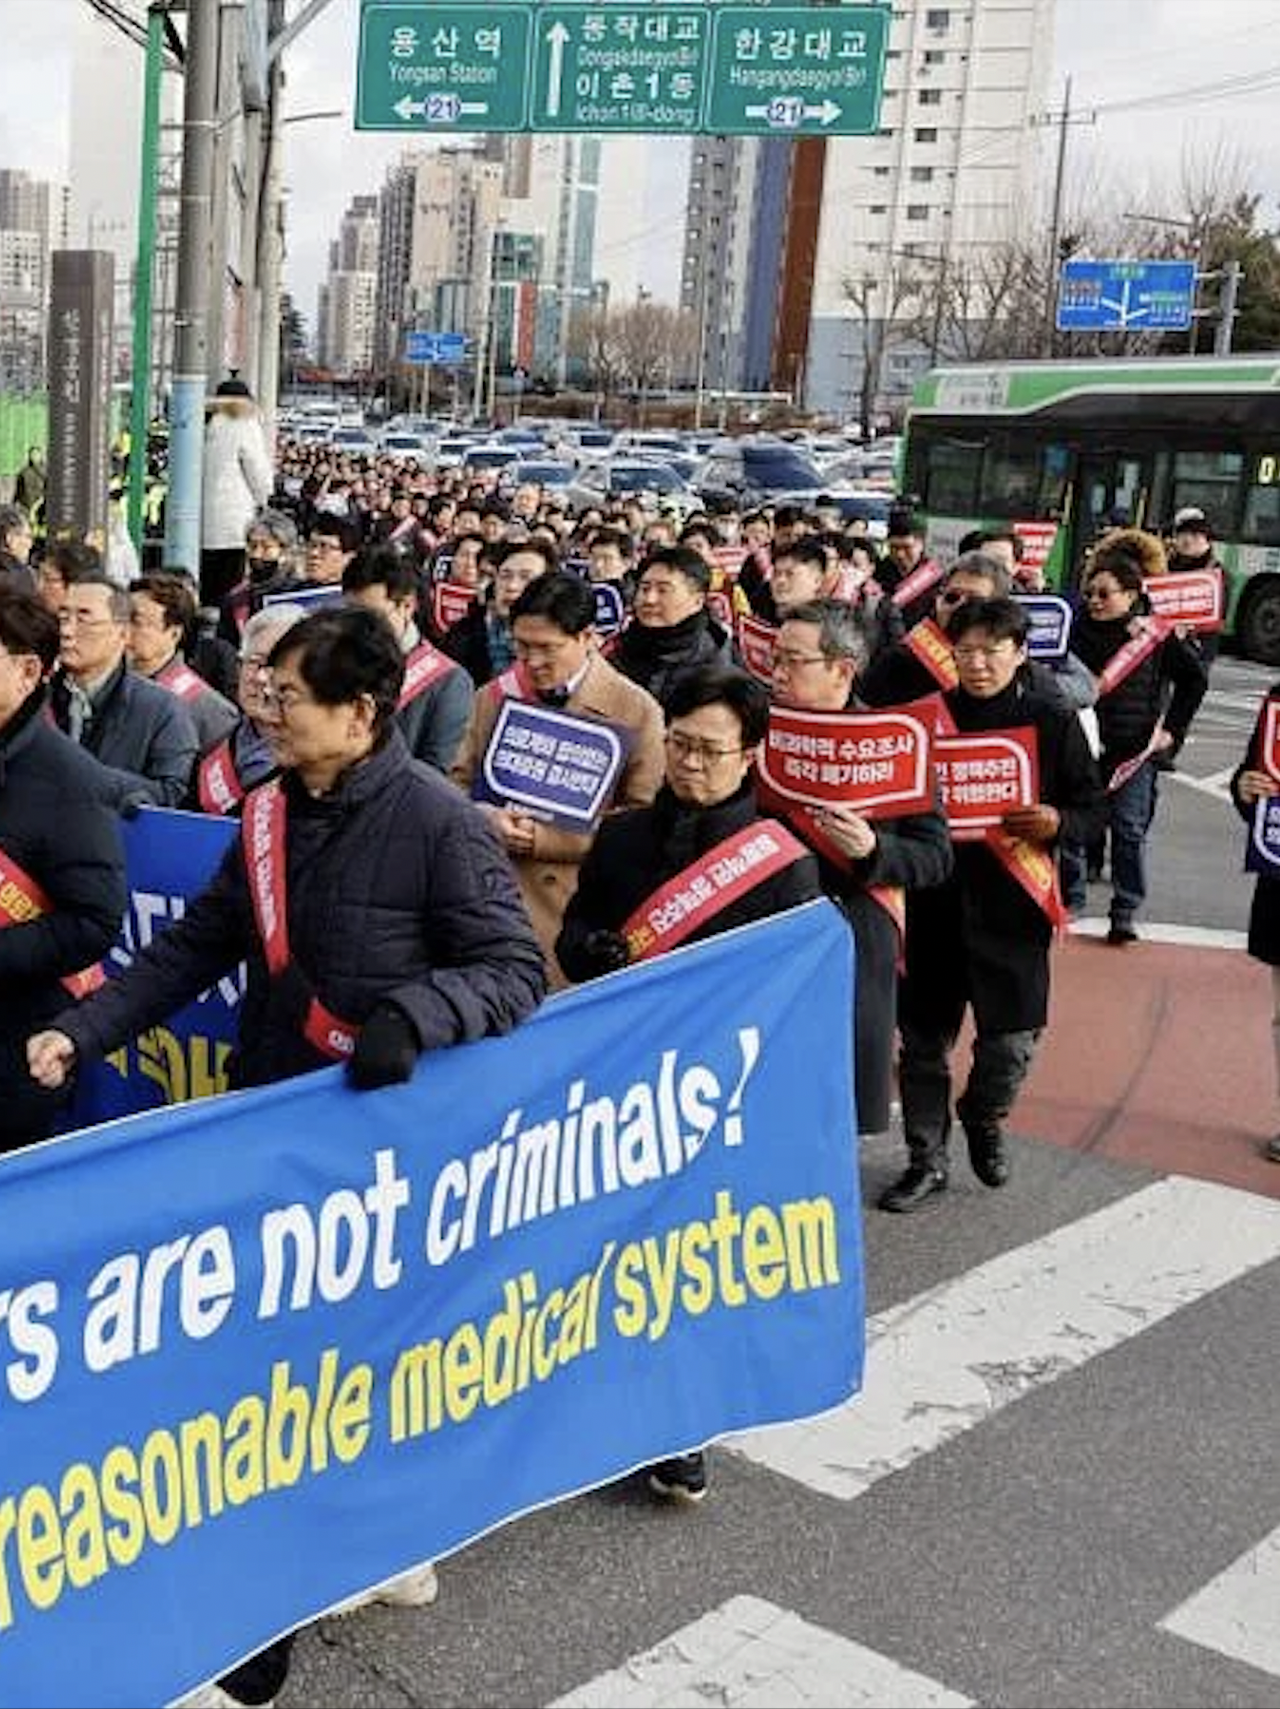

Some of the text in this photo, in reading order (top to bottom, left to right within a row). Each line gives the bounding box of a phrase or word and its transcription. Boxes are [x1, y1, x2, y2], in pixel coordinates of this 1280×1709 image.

[390, 26, 501, 59] 용산역
[581, 14, 700, 42] 동작대교
[734, 27, 867, 60] 한강대교
[389, 62, 498, 86] Yongsan Station
[838, 731, 915, 761] 수요조사
[820, 759, 895, 787] 폐기하라
[83, 1224, 236, 1372] are
[258, 1147, 410, 1320] not
[425, 1026, 760, 1267] criminals!
[389, 1242, 612, 1444] medical
[613, 1190, 841, 1342] system
